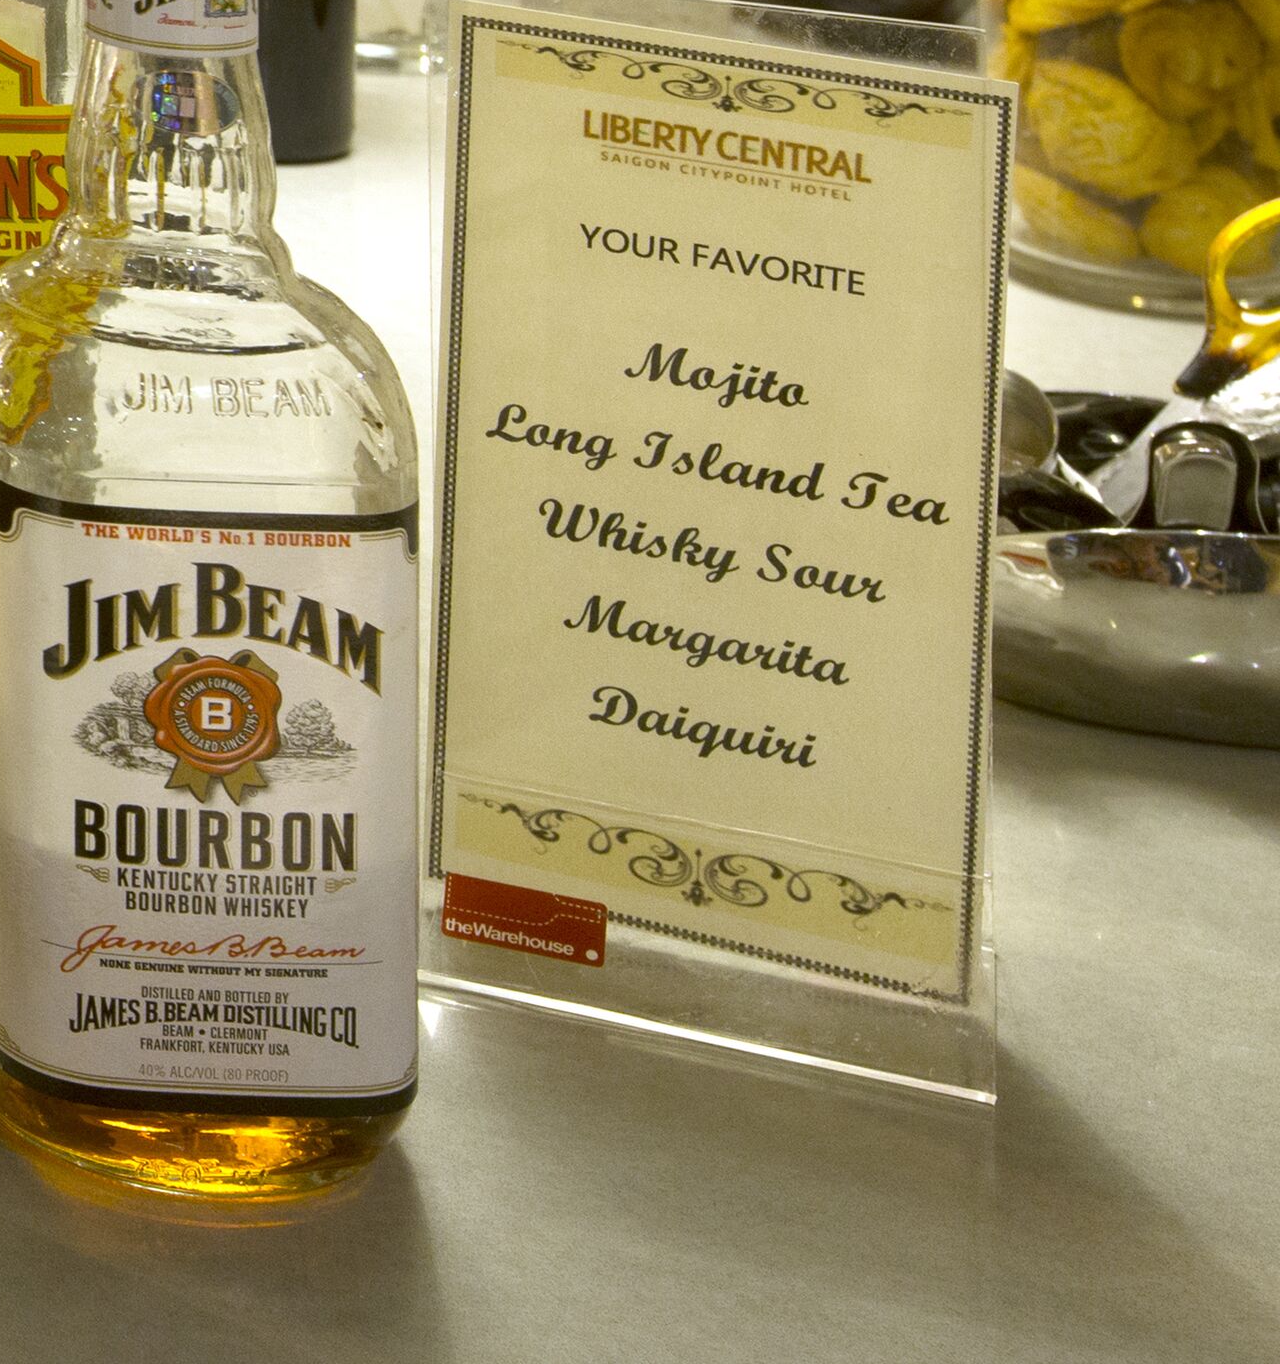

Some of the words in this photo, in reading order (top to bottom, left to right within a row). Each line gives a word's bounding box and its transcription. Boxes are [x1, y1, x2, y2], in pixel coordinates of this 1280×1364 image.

[583, 108, 713, 157] LIBERTY
[716, 131, 872, 185] CENTRAL
[600, 150, 671, 171] SAIGON
[679, 164, 780, 190] CITYPOINT
[790, 182, 852, 202] HOTEL
[579, 223, 681, 264] YOUR
[692, 242, 866, 296] FAVORITE
[123, 373, 192, 414] JIM
[210, 376, 333, 418] BEAM
[624, 343, 809, 408] Mojito
[485, 404, 617, 472] Long
[633, 431, 825, 501] Island
[841, 472, 950, 526] Tea
[81, 523, 120, 540] THE
[127, 526, 212, 544] WORLD'S
[264, 531, 352, 549] BOURBON
[538, 498, 740, 583] Whisky
[756, 543, 886, 603] Sour
[42, 578, 181, 680] JIM
[191, 562, 386, 697] BEAM
[563, 595, 849, 686] Margarita
[179, 679, 207, 701] BEAM
[207, 677, 252, 704] FORMULA
[174, 716, 219, 752] STANDARD
[219, 733, 249, 752] SINCE
[243, 712, 260, 736] 1795
[200, 696, 233, 732] B
[589, 686, 817, 768] Daiquiri
[74, 798, 358, 872] BOURBON
[116, 866, 218, 893] KENTUCKY
[225, 875, 318, 897] STRAIGHT
[125, 890, 217, 916] BOURBON
[224, 896, 309, 919] WHISKEY
[60, 924, 204, 973] James
[251, 936, 366, 959] Beam
[445, 917, 575, 956] theWarehouse
[99, 957, 131, 971] NONE
[134, 961, 185, 974] GENUINE
[187, 964, 242, 977] WITHOUT
[244, 967, 263, 978] MY
[265, 967, 328, 979] SIGNATURE
[140, 985, 195, 1002] DISTILLED
[198, 989, 221, 1003] AND
[224, 989, 271, 1004] BOTTLED
[274, 992, 290, 1004] BY
[69, 992, 141, 1034] JAMES
[223, 1003, 327, 1038] DISTILLING
[330, 1006, 360, 1049] CO.
[162, 1025, 194, 1038] BEAM
[210, 1027, 268, 1041] CLERMONT
[208, 1041, 264, 1056] KENTUCKY
[268, 1043, 290, 1056] USA
[139, 1064, 166, 1078] 40%
[169, 1066, 219, 1080] ALC/VOL
[223, 1068, 242, 1082] (80
[244, 1070, 290, 1083] PROOF)
